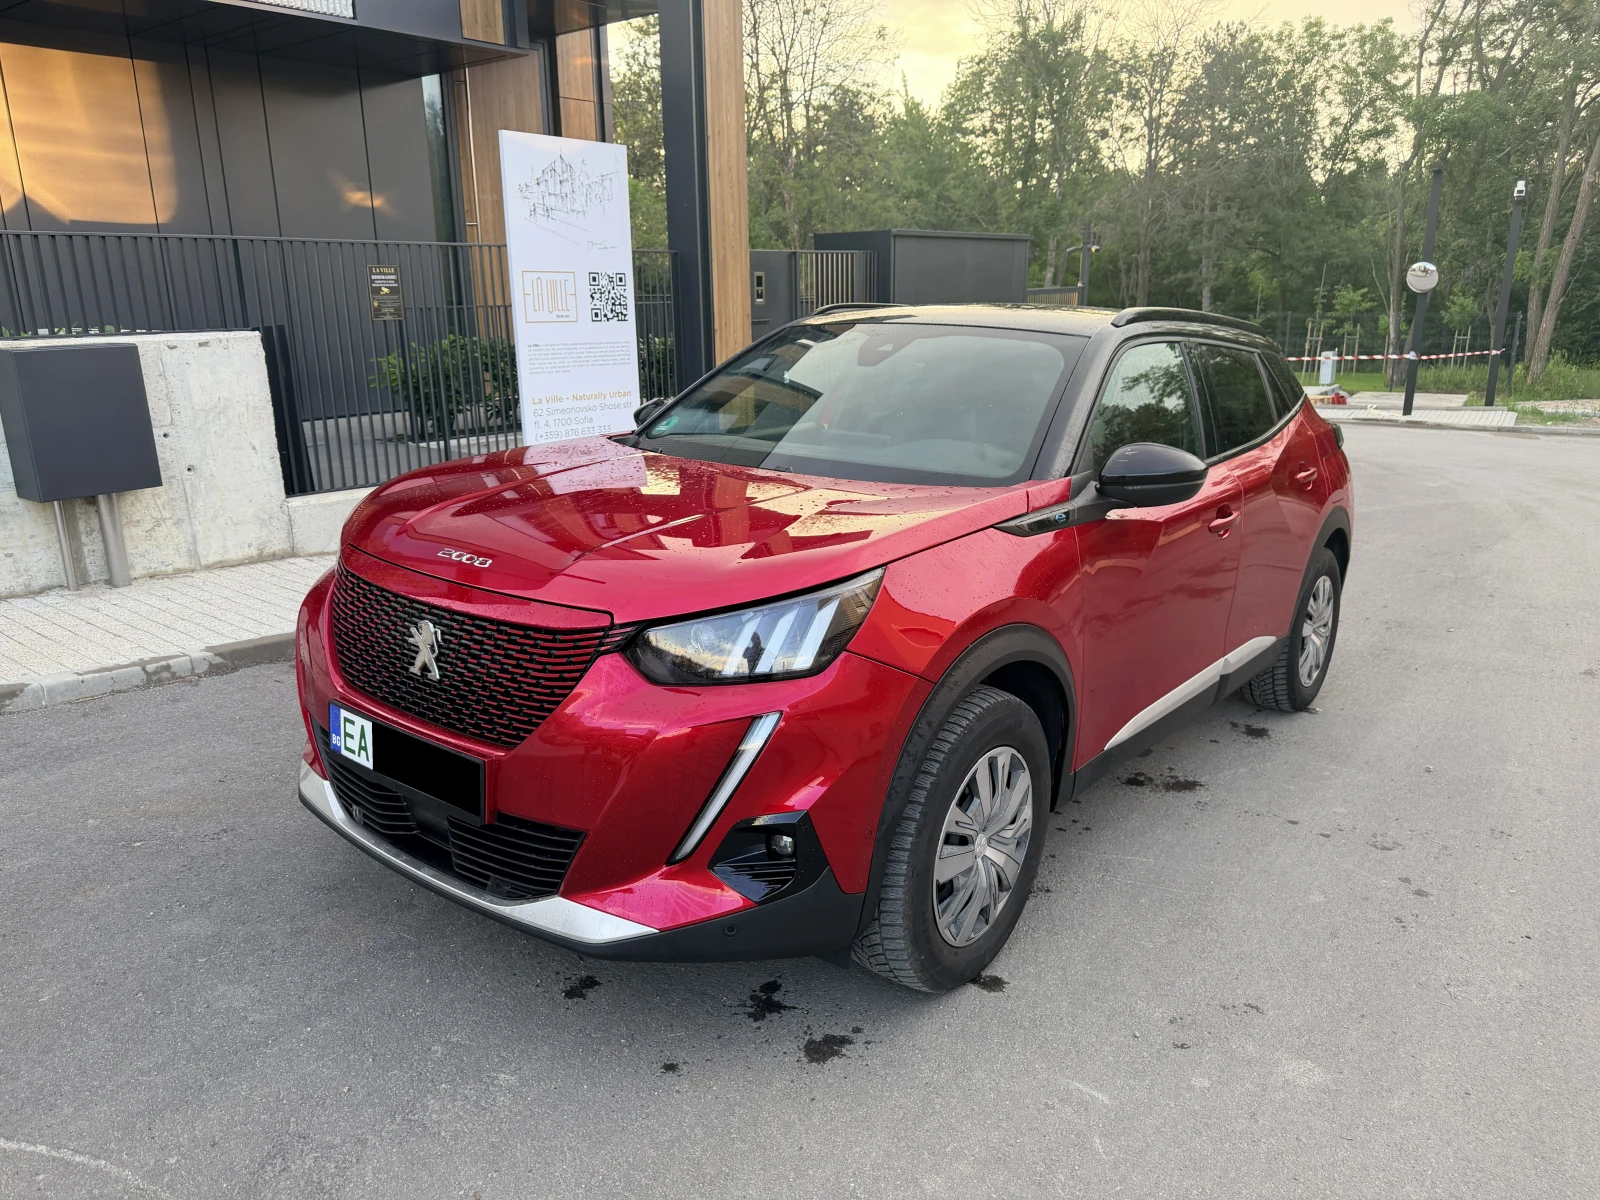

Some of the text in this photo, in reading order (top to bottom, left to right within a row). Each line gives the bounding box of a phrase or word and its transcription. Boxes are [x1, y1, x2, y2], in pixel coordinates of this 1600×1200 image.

[532, 397, 543, 405] La
[545, 395, 563, 404] Ville
[572, 391, 607, 402] Naturally
[609, 389, 632, 398] Urban
[533, 401, 634, 417] 62 Simeonovsko Shose str.
[553, 417, 573, 427] 1700
[574, 416, 594, 425] Sofia
[534, 425, 612, 442] (+359) 876 633 333
[437, 547, 493, 568] 2008
[332, 733, 341, 747] BG
[343, 715, 370, 762] EA
